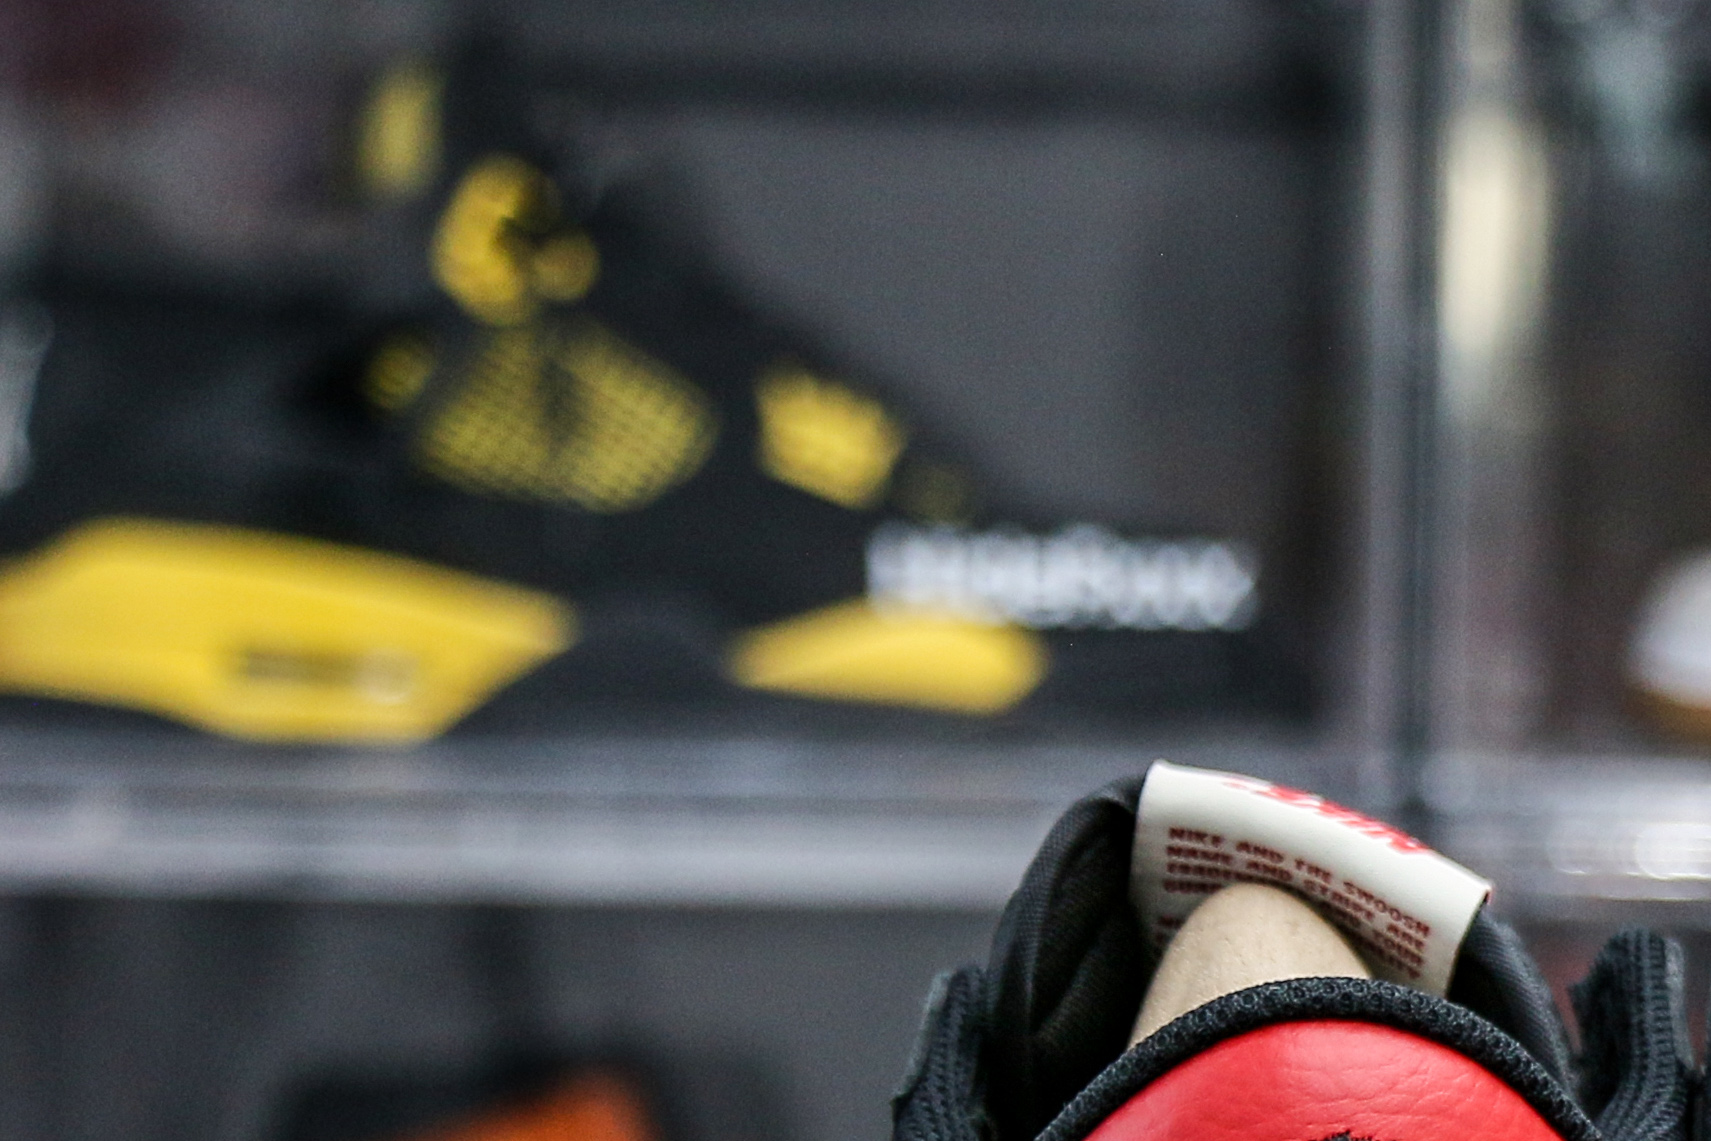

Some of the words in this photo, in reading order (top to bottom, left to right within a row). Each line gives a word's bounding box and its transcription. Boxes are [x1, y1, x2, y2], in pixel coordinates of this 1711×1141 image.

[1236, 842, 1283, 864] AND
[1344, 881, 1430, 937] SWOOSH
[1247, 862, 1292, 881] AND
